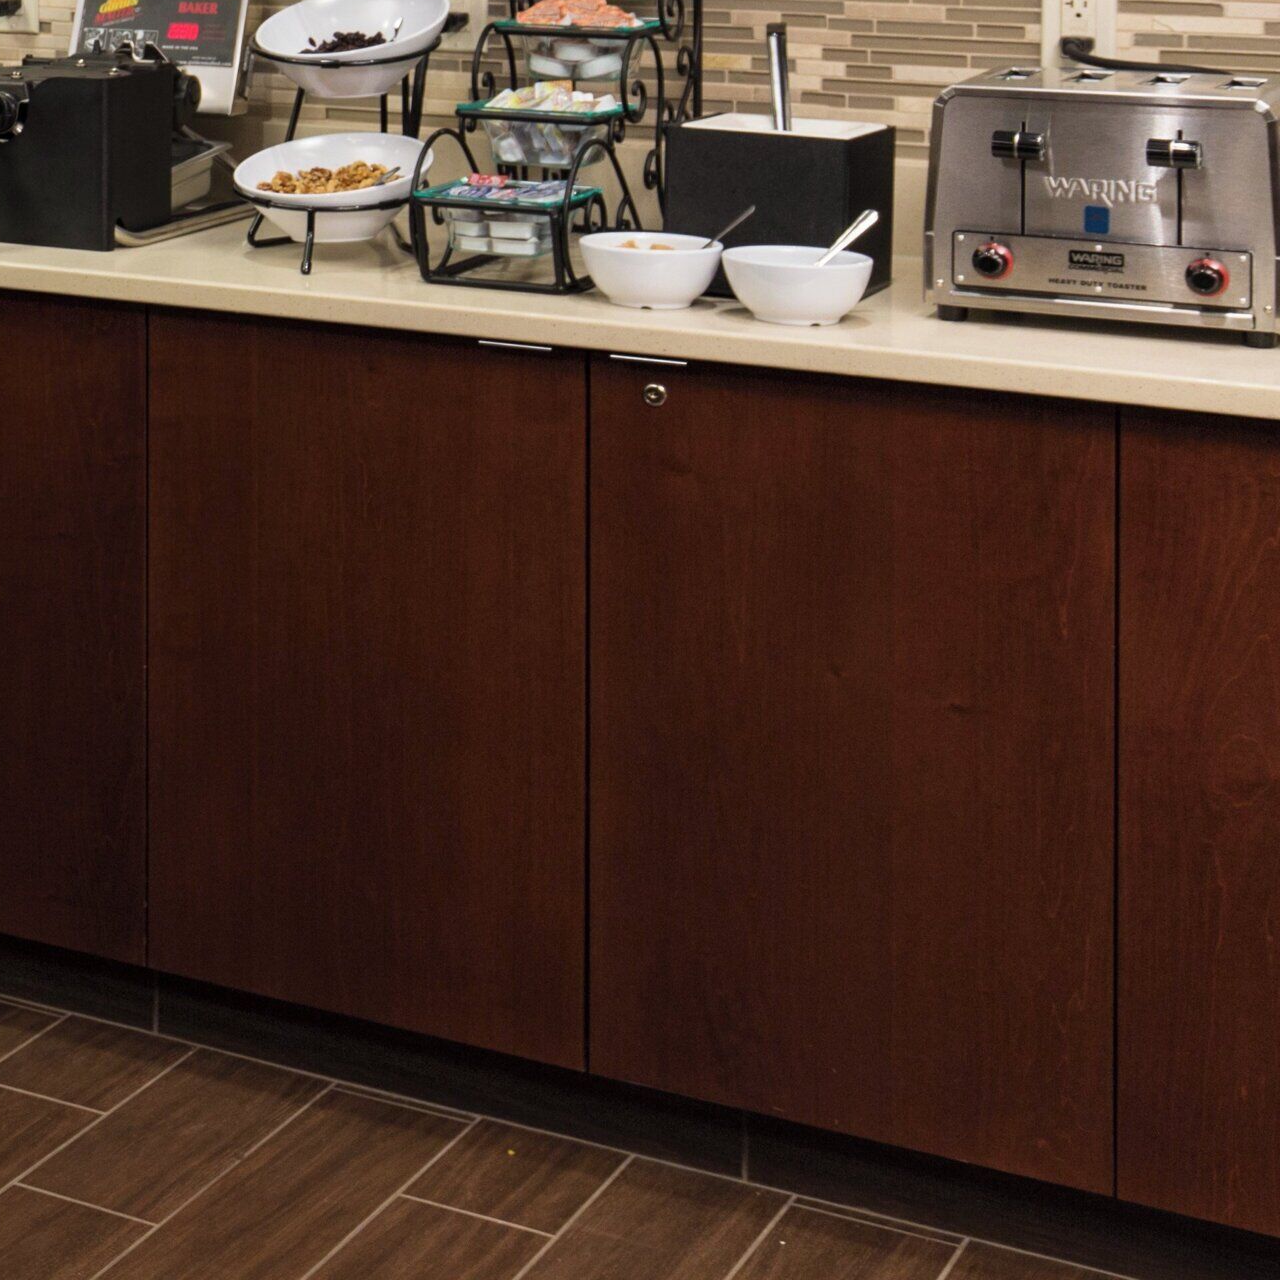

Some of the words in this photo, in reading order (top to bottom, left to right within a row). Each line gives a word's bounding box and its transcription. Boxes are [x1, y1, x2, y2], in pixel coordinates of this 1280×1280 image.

[178, 1, 218, 15] BAKER
[1044, 176, 1158, 208] WARING
[1071, 253, 1123, 266] WARING
[1048, 278, 1077, 286] HEAVY
[1107, 281, 1148, 291] TOASTER
